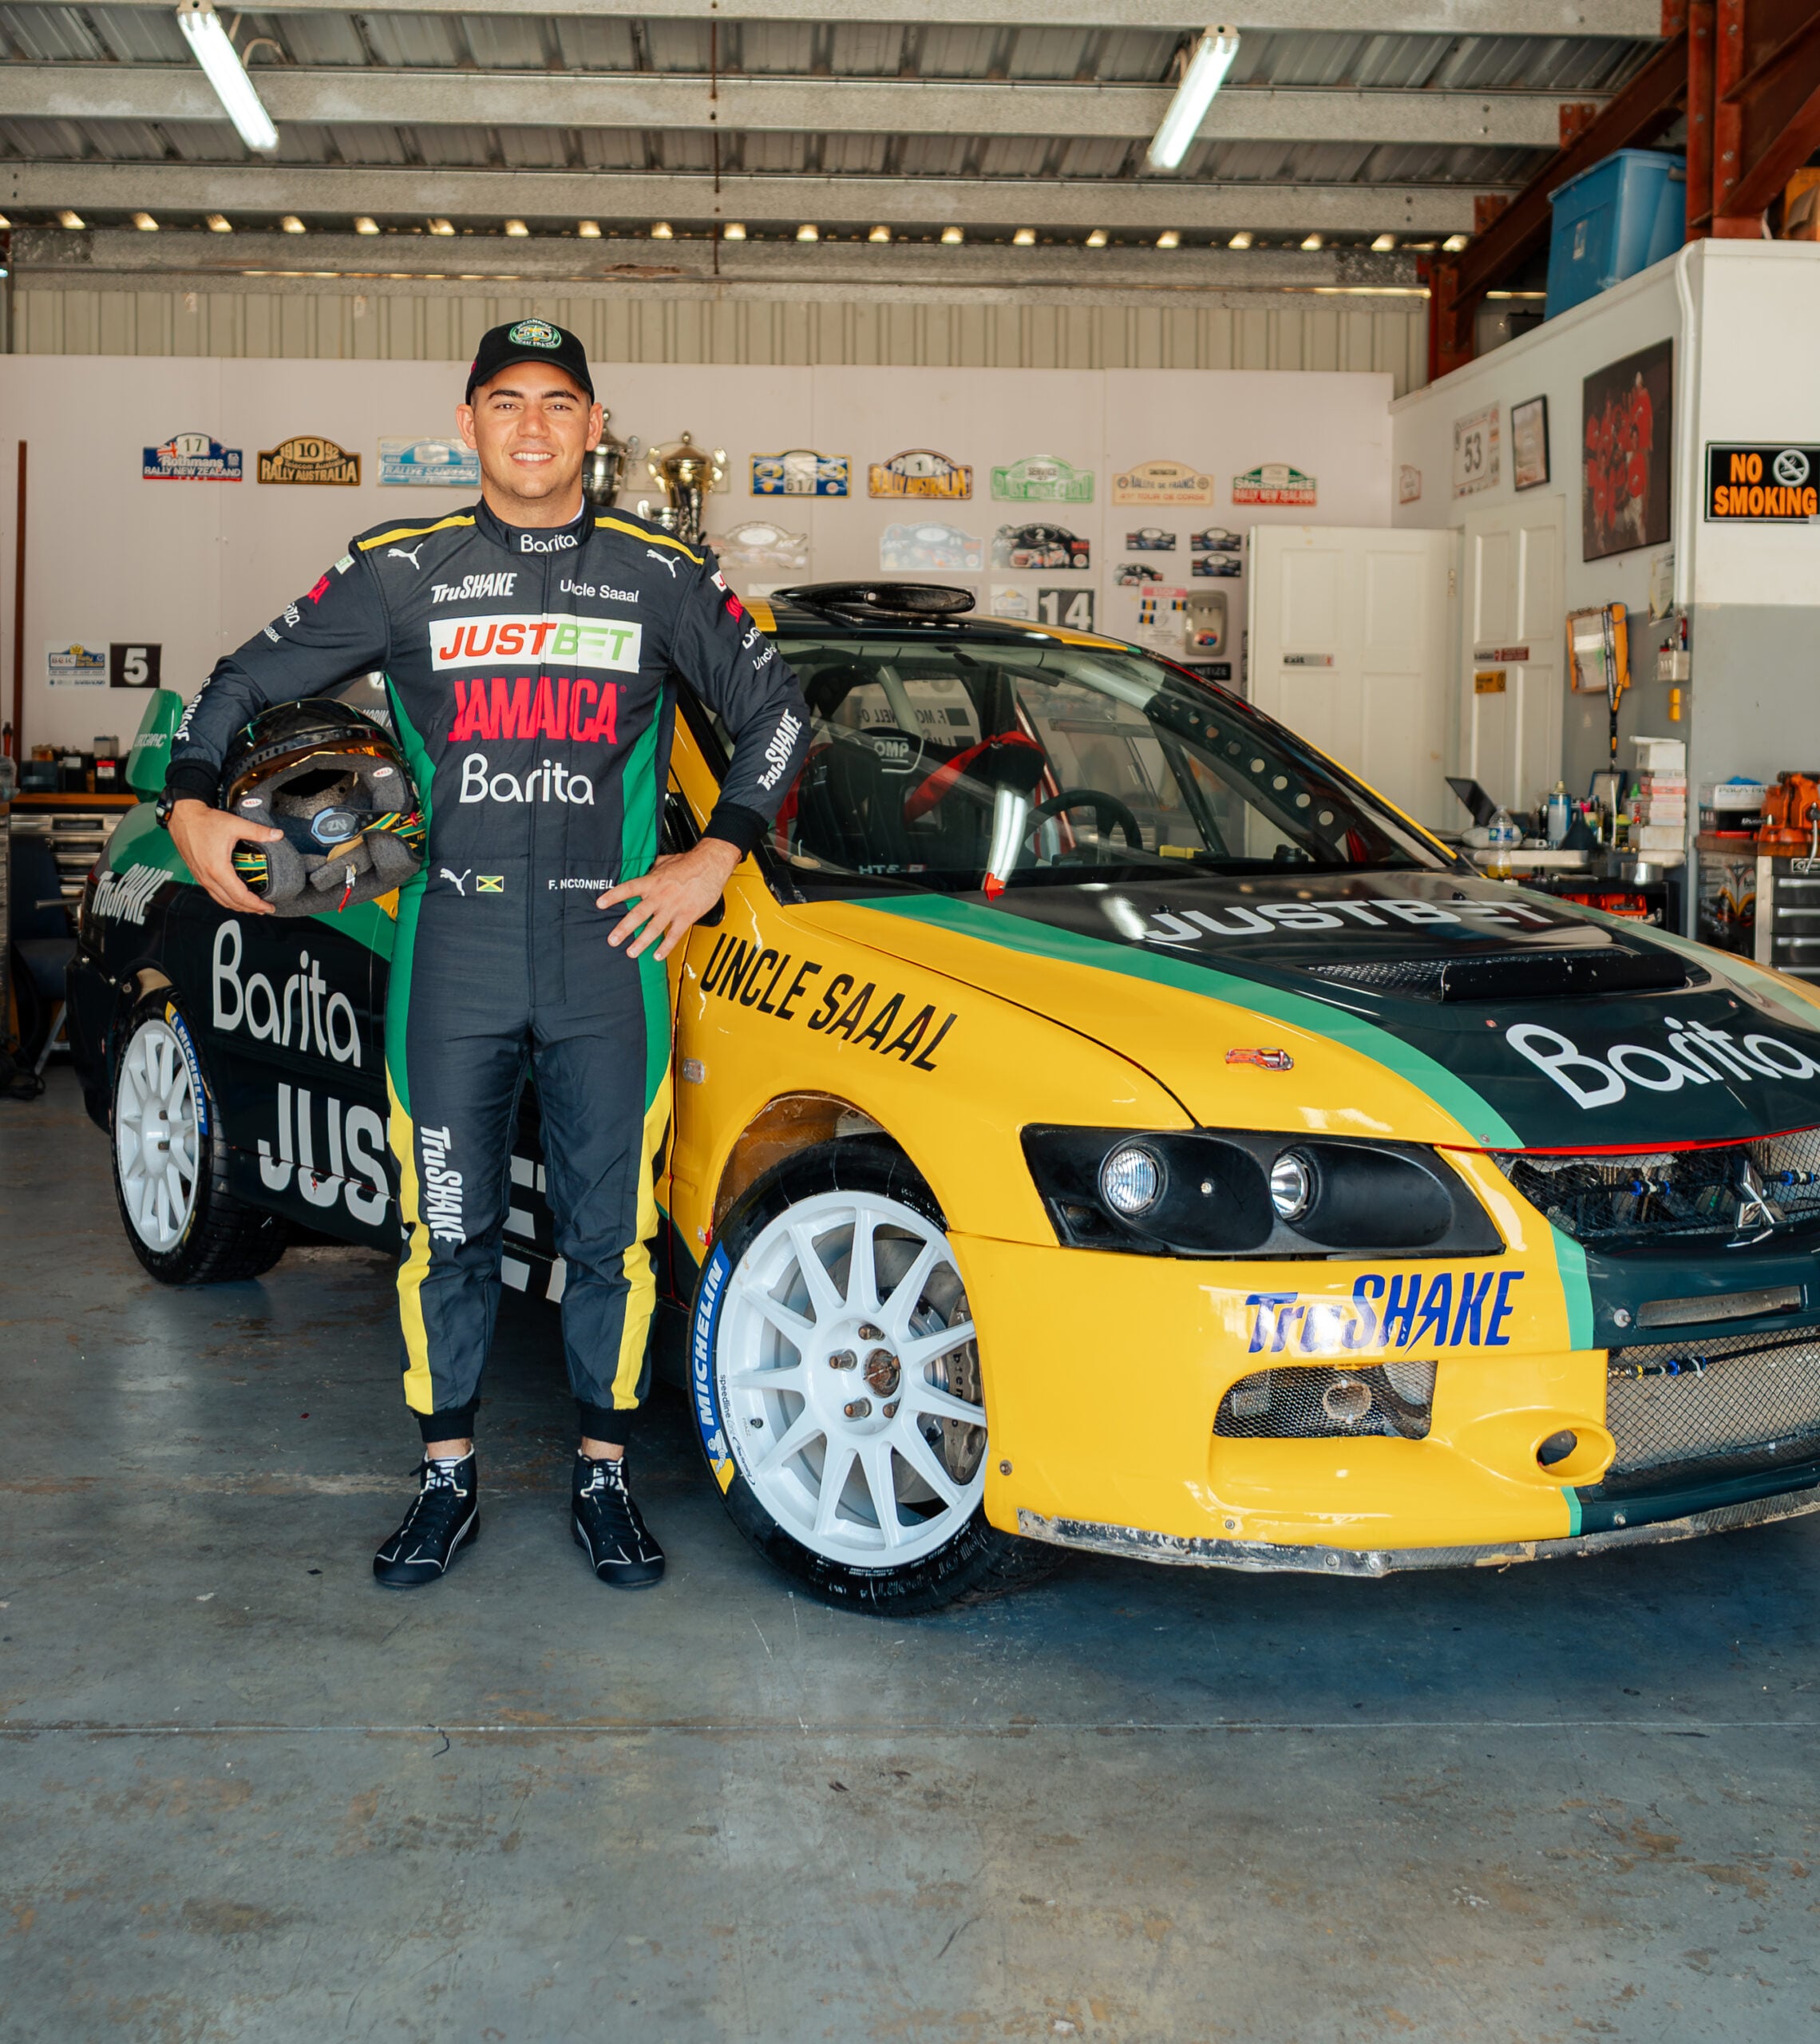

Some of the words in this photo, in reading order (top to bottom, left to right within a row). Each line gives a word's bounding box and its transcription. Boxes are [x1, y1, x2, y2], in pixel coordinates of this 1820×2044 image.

[184, 438, 202, 452] 17
[299, 442, 320, 458] 10
[1464, 431, 1482, 473] 53
[144, 465, 172, 475] RALLY
[174, 466, 196, 476] NEW
[197, 466, 241, 477] ZEALAND
[261, 458, 295, 481] RALLY
[295, 461, 358, 481] AUSTRALIA
[385, 465, 423, 474] RALLYE
[916, 461, 923, 471] 1
[1730, 453, 1763, 484] NO
[785, 478, 814, 493] 617
[1714, 485, 1818, 517] SMOKING
[520, 533, 578, 553] Barita
[1035, 528, 1046, 540] 2
[431, 572, 518, 604] TruSHAKE
[599, 584, 640, 604] Saaal
[1040, 590, 1092, 631] 14
[439, 622, 635, 662] JUSTBET
[123, 648, 149, 686] 5
[448, 675, 619, 745] JAMAICA
[758, 708, 802, 791] TruSHAKE
[874, 740, 909, 758] OMP
[459, 752, 595, 806] Barita
[548, 879, 558, 890] F.
[1142, 899, 1554, 941] JUSTBET
[212, 919, 362, 1068] Barita
[699, 932, 823, 1021] UNCLE
[807, 972, 958, 1072] SAAAL
[176, 1027, 206, 1124] MICHELIN
[1505, 1016, 1820, 1110] Barita
[420, 1126, 467, 1246] TruSHAKE
[1244, 1270, 1525, 1356] TruSHAKE
[694, 1257, 724, 1427] MICHELIN
[719, 1373, 731, 1419] speedline
